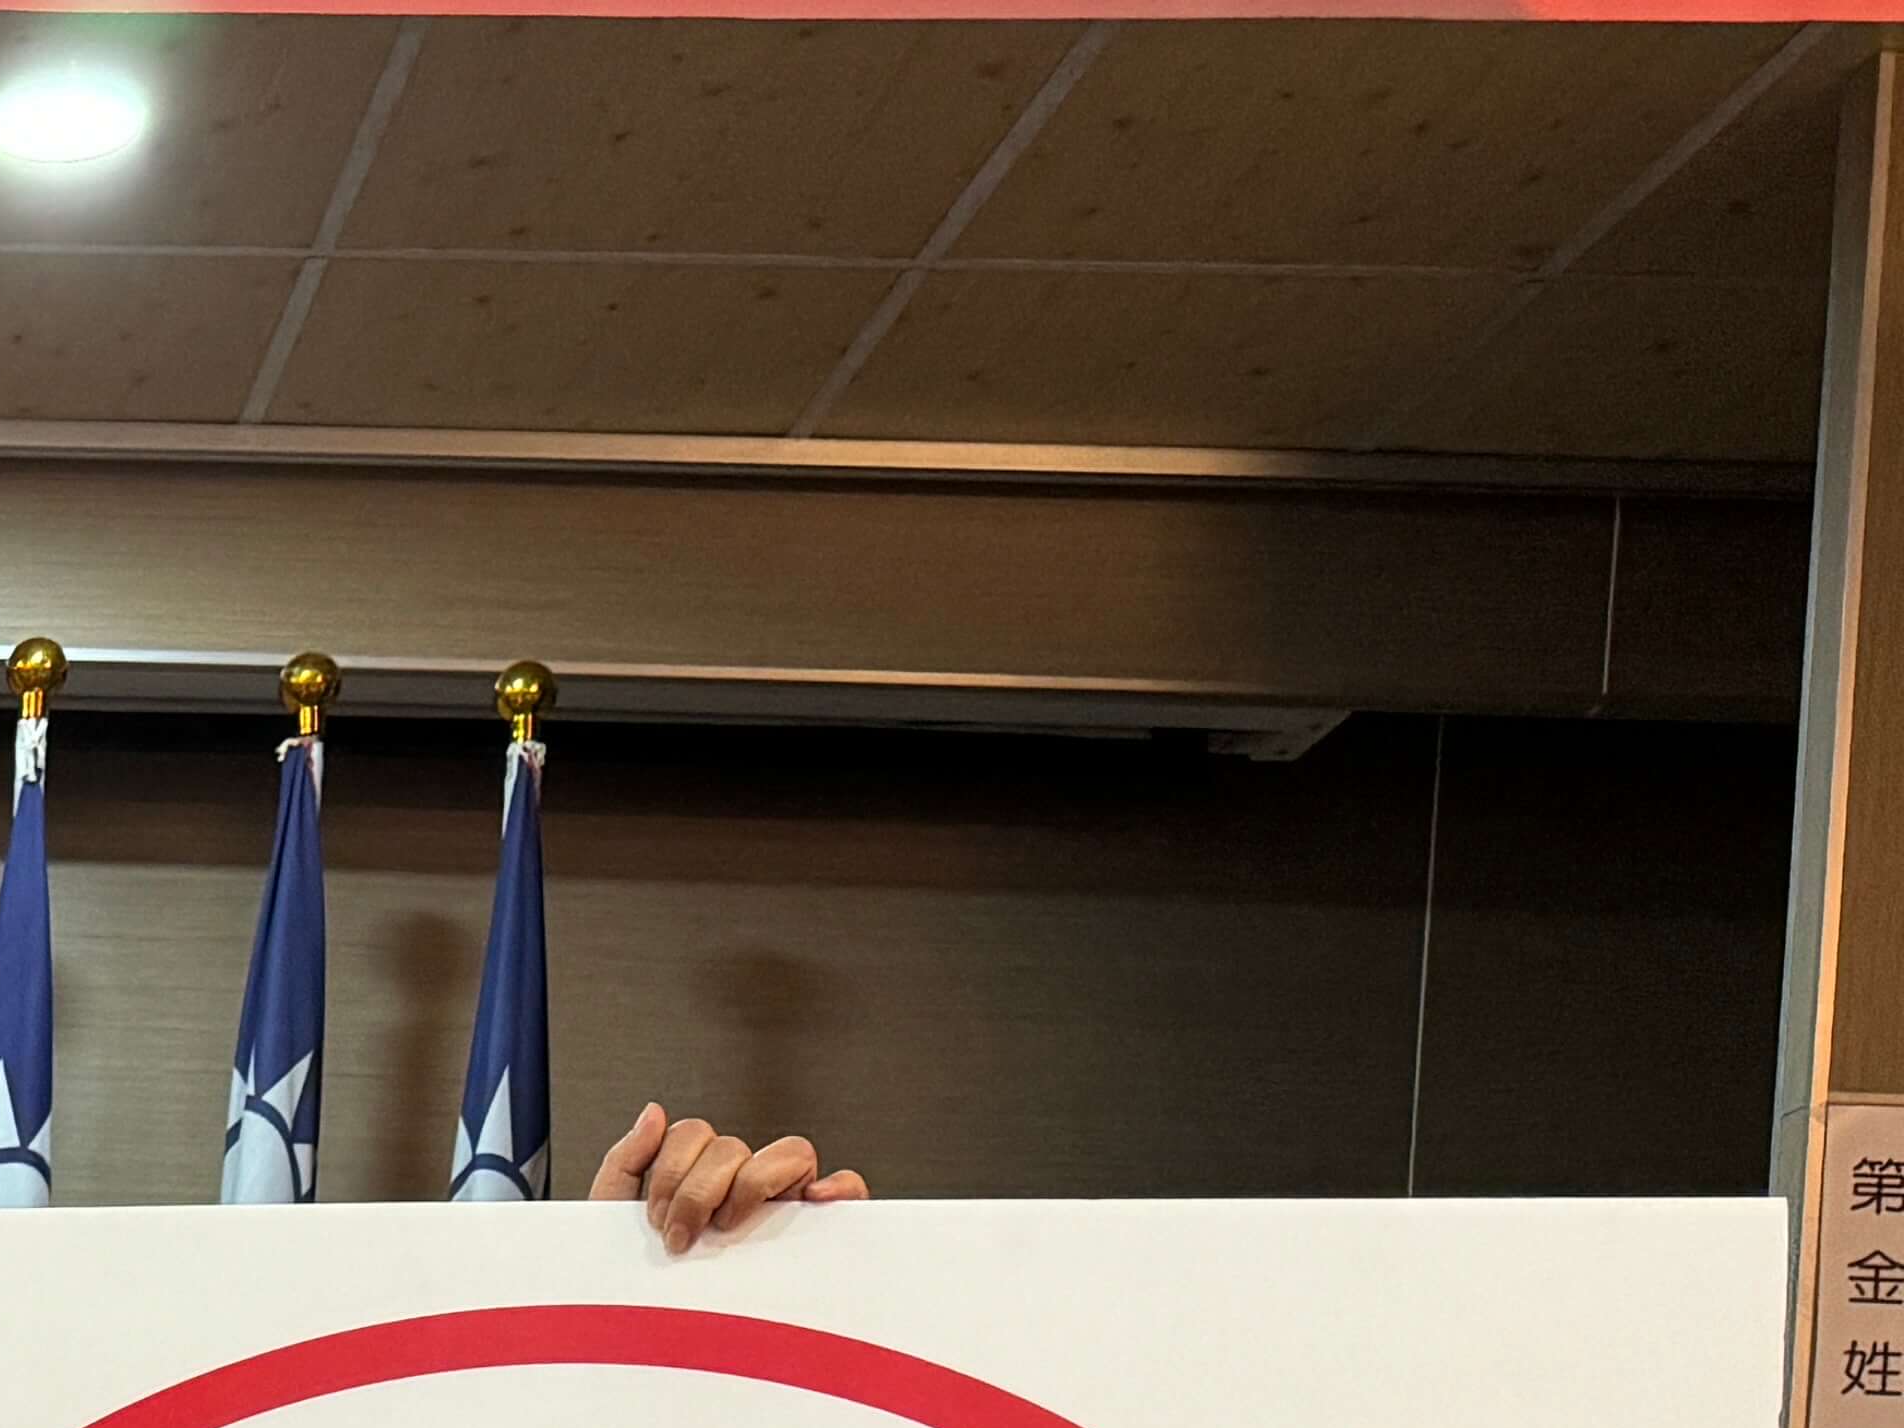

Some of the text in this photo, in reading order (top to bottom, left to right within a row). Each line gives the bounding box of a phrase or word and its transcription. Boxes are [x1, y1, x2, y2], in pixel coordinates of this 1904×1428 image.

[1850, 1157, 1904, 1215] 第
[1847, 1250, 1904, 1304] 金
[1841, 1340, 1903, 1397] 姓
